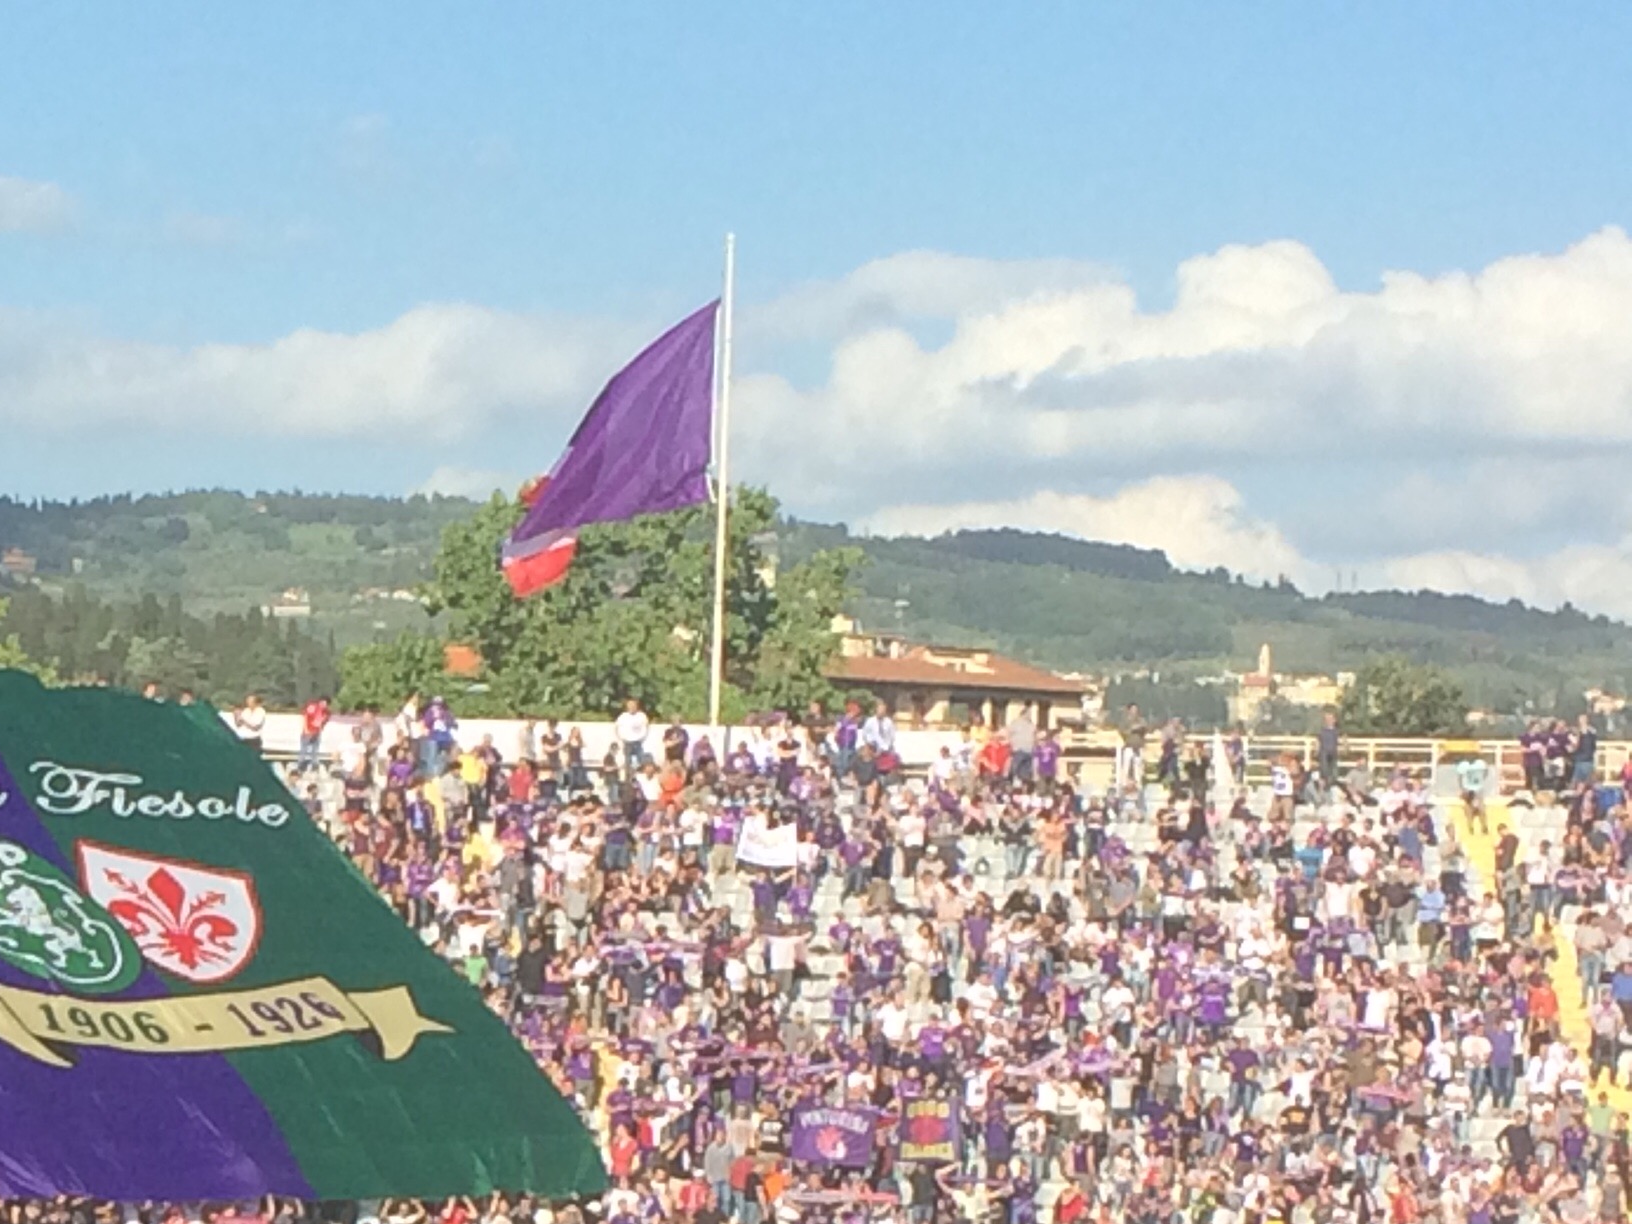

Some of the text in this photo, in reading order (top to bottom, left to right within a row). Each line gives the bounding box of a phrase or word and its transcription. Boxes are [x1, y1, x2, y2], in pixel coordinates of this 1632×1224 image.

[30, 760, 290, 827] Fiesole
[40, 1002, 169, 1045] 1906
[226, 992, 346, 1038] 1926
